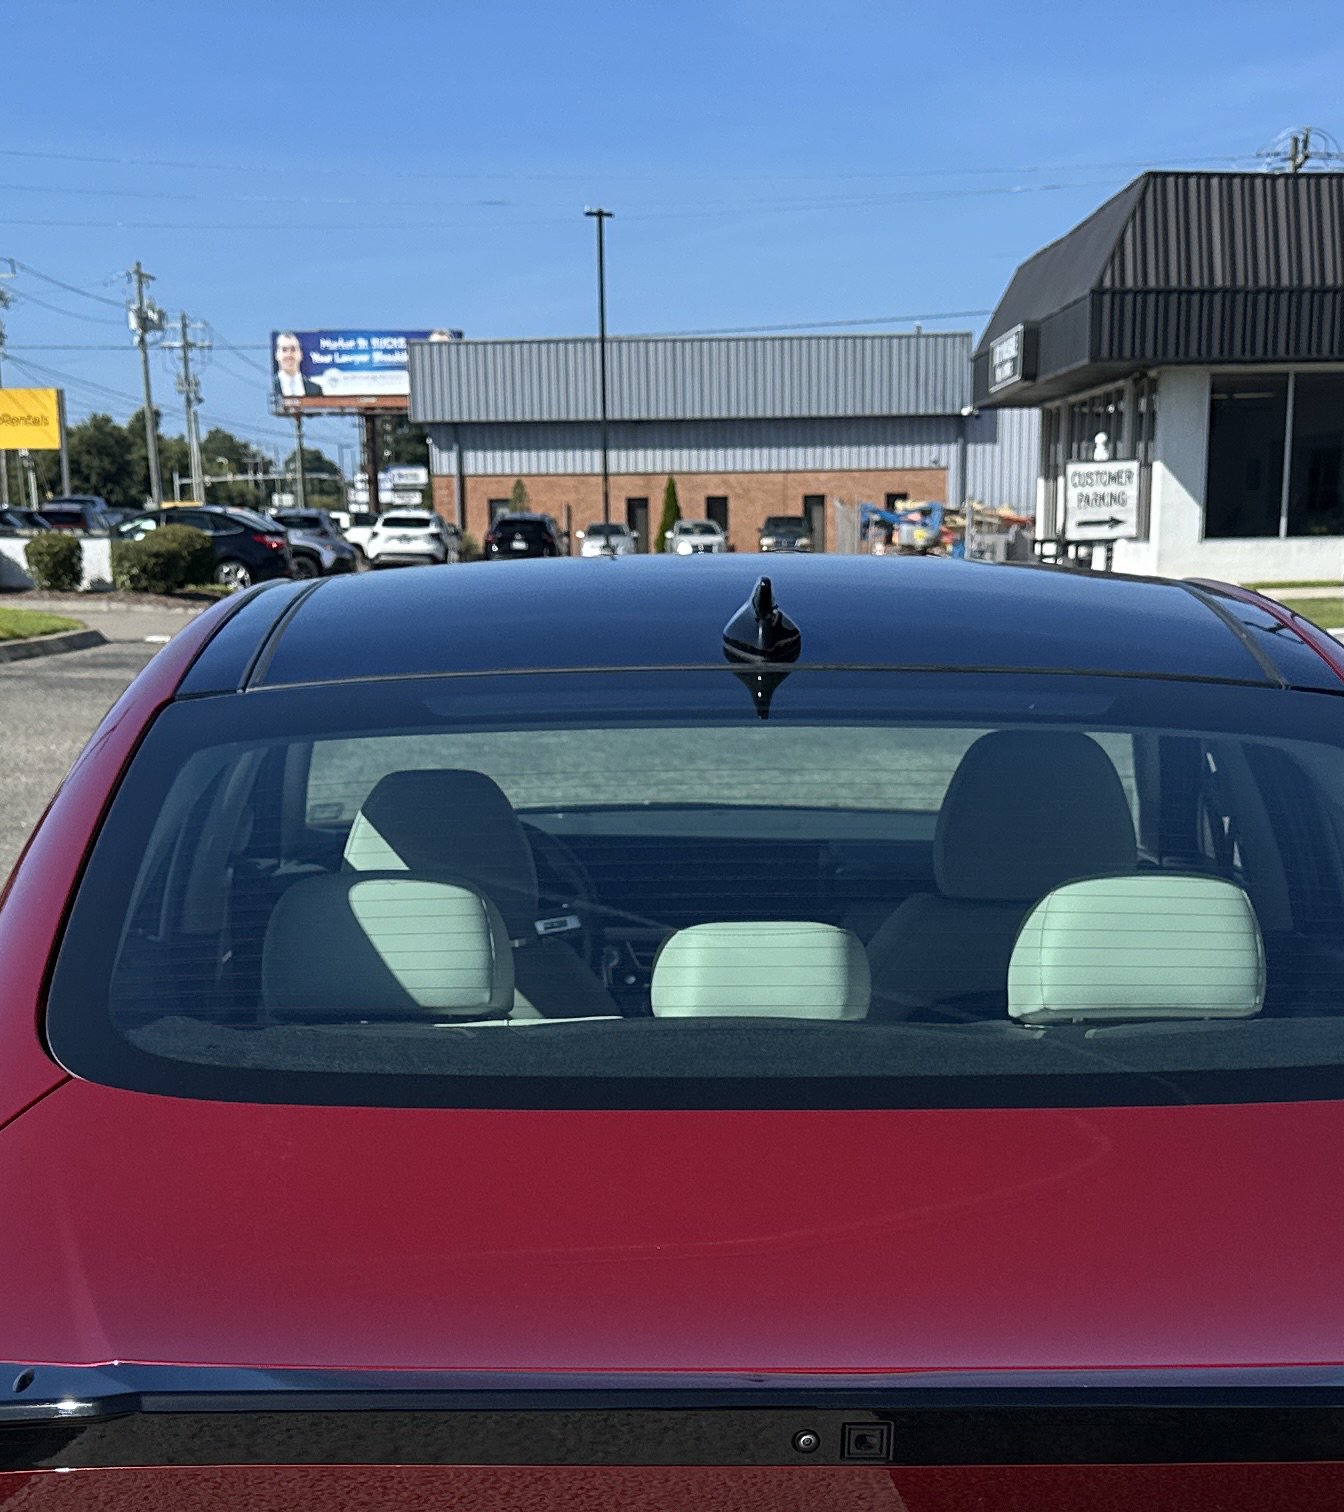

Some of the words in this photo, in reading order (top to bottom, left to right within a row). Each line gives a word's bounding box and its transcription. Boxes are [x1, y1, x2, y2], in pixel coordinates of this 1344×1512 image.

[310, 351, 333, 364] Your
[1071, 469, 1134, 488] CUSTOMER
[1077, 491, 1127, 509] PARKING
